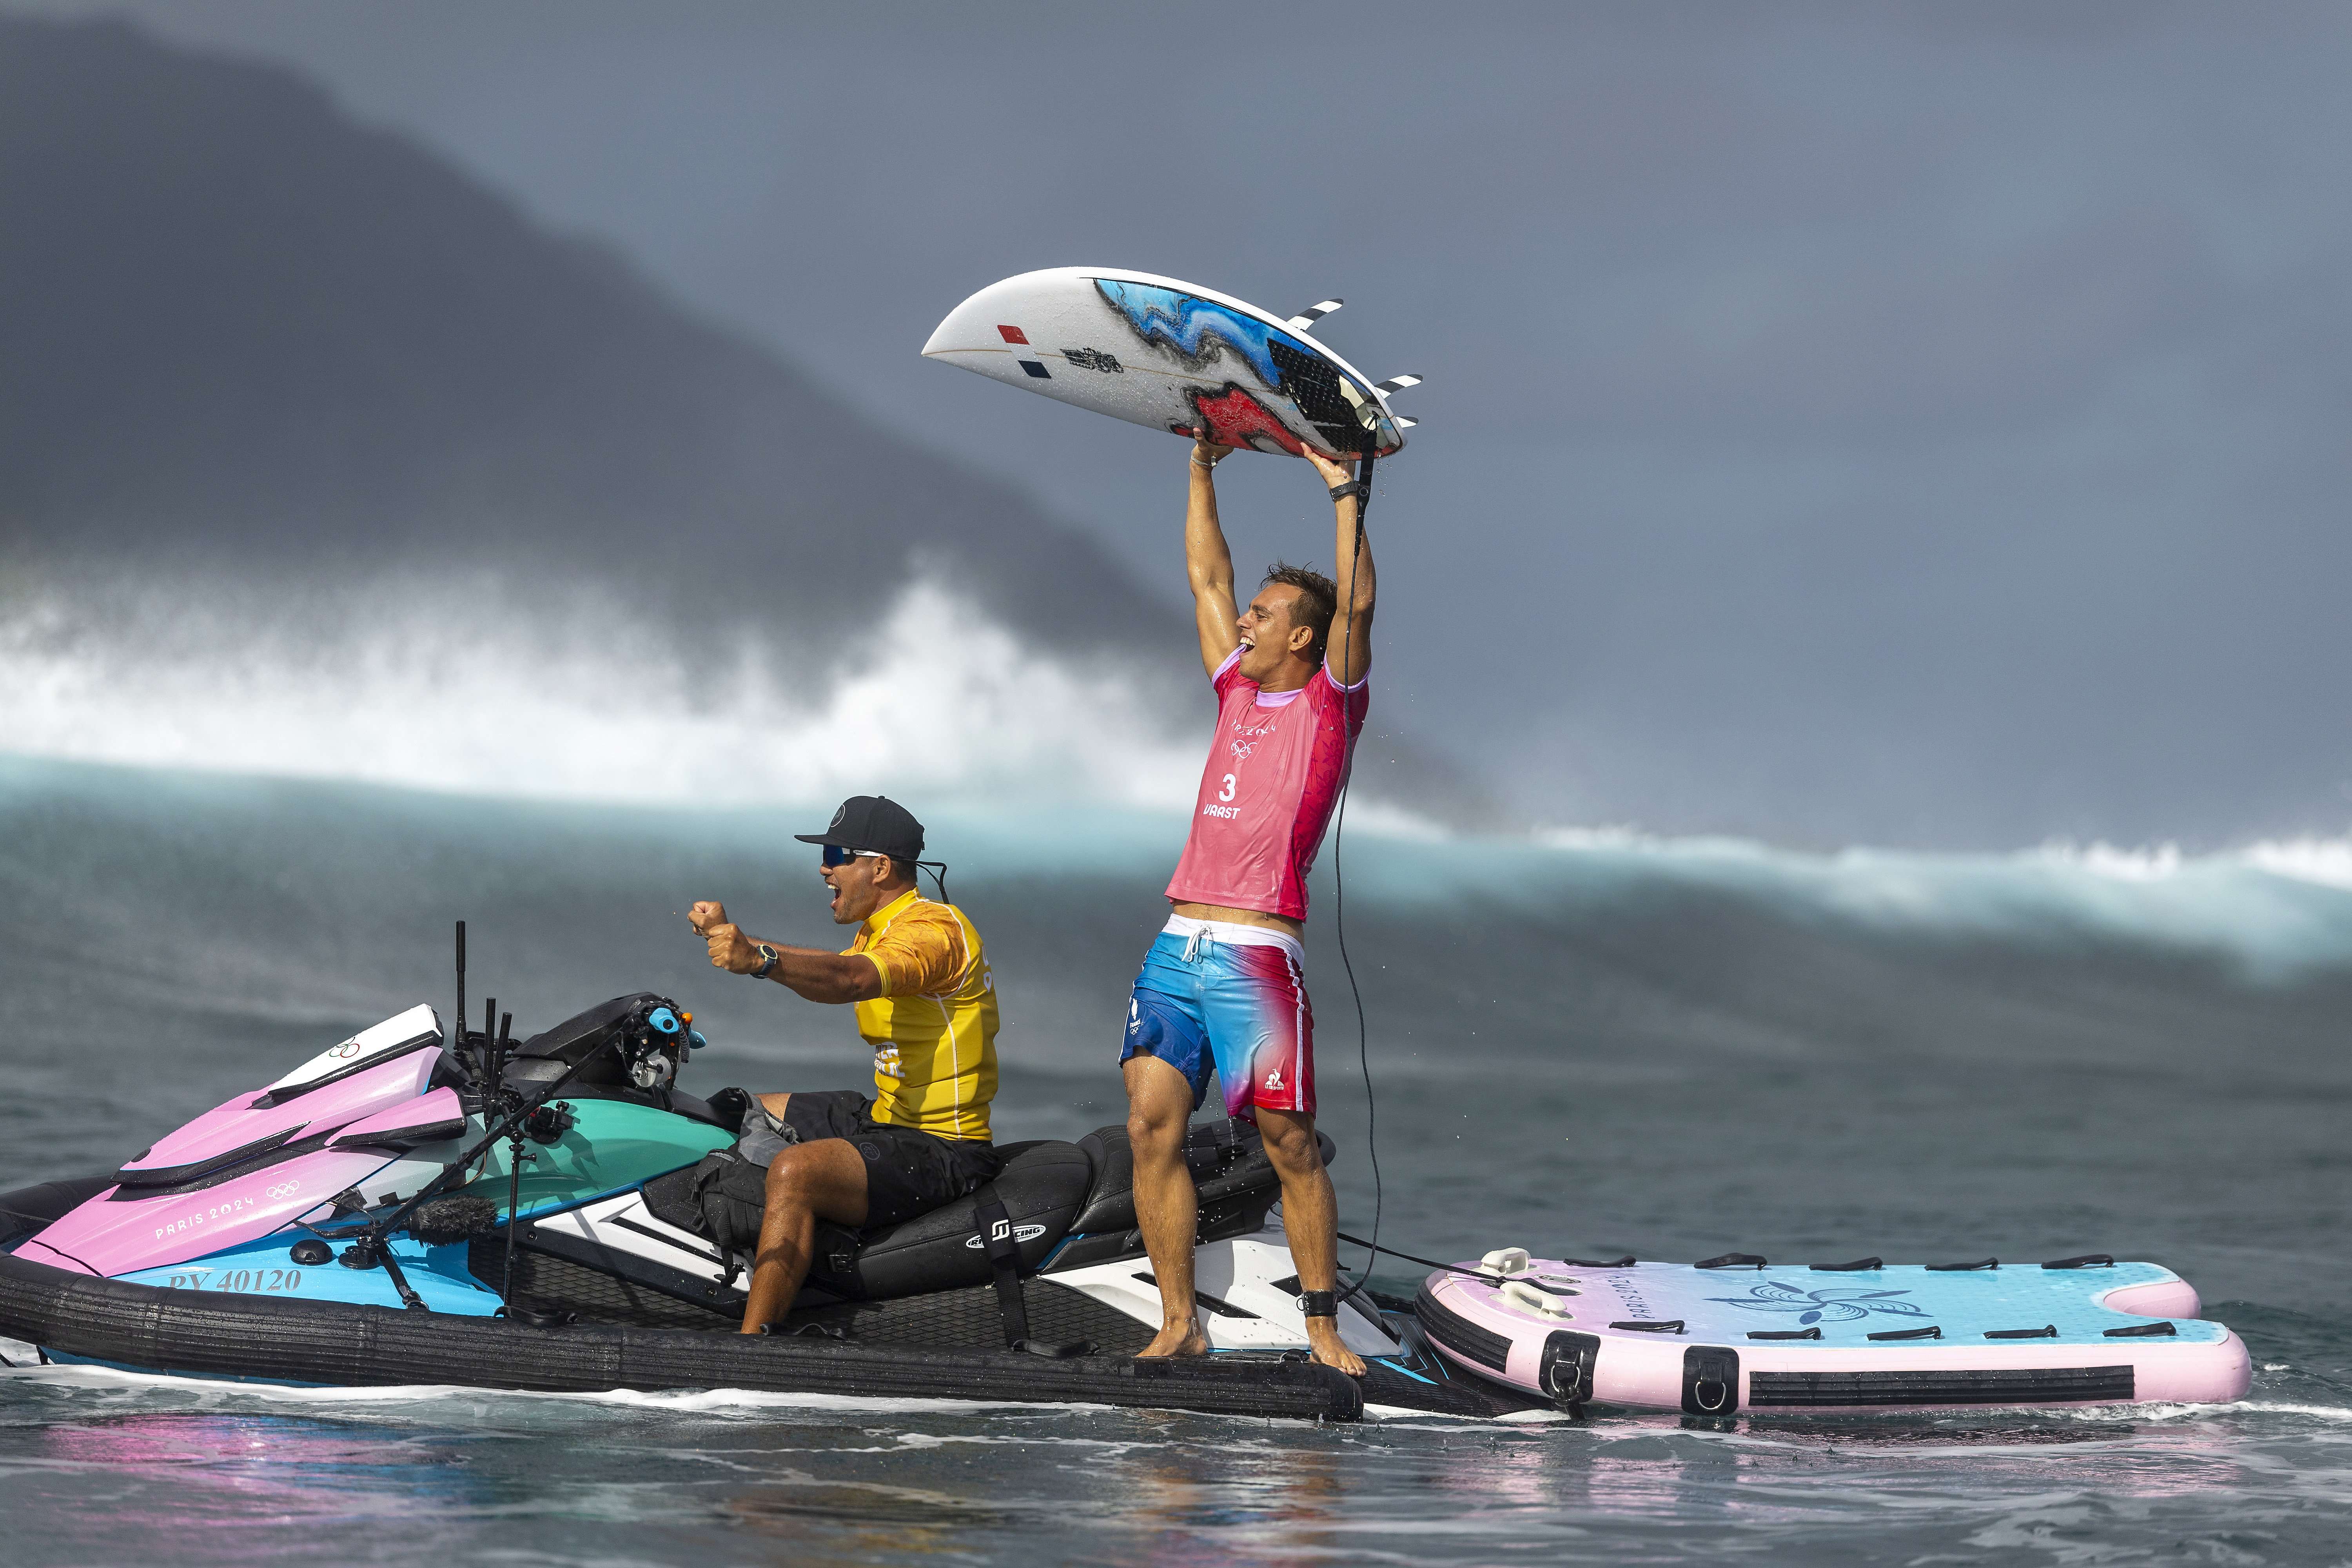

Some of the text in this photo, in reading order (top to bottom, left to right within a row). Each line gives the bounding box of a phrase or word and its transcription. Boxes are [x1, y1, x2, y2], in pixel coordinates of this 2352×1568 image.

[1219, 773, 1236, 802] 3
[1203, 804, 1241, 820] VAAST
[156, 1197, 254, 1240] PARIS 2024
[1014, 1227, 1040, 1237] CING
[216, 1270, 301, 1293] 40120
[1605, 1276, 1639, 1294] 2024
